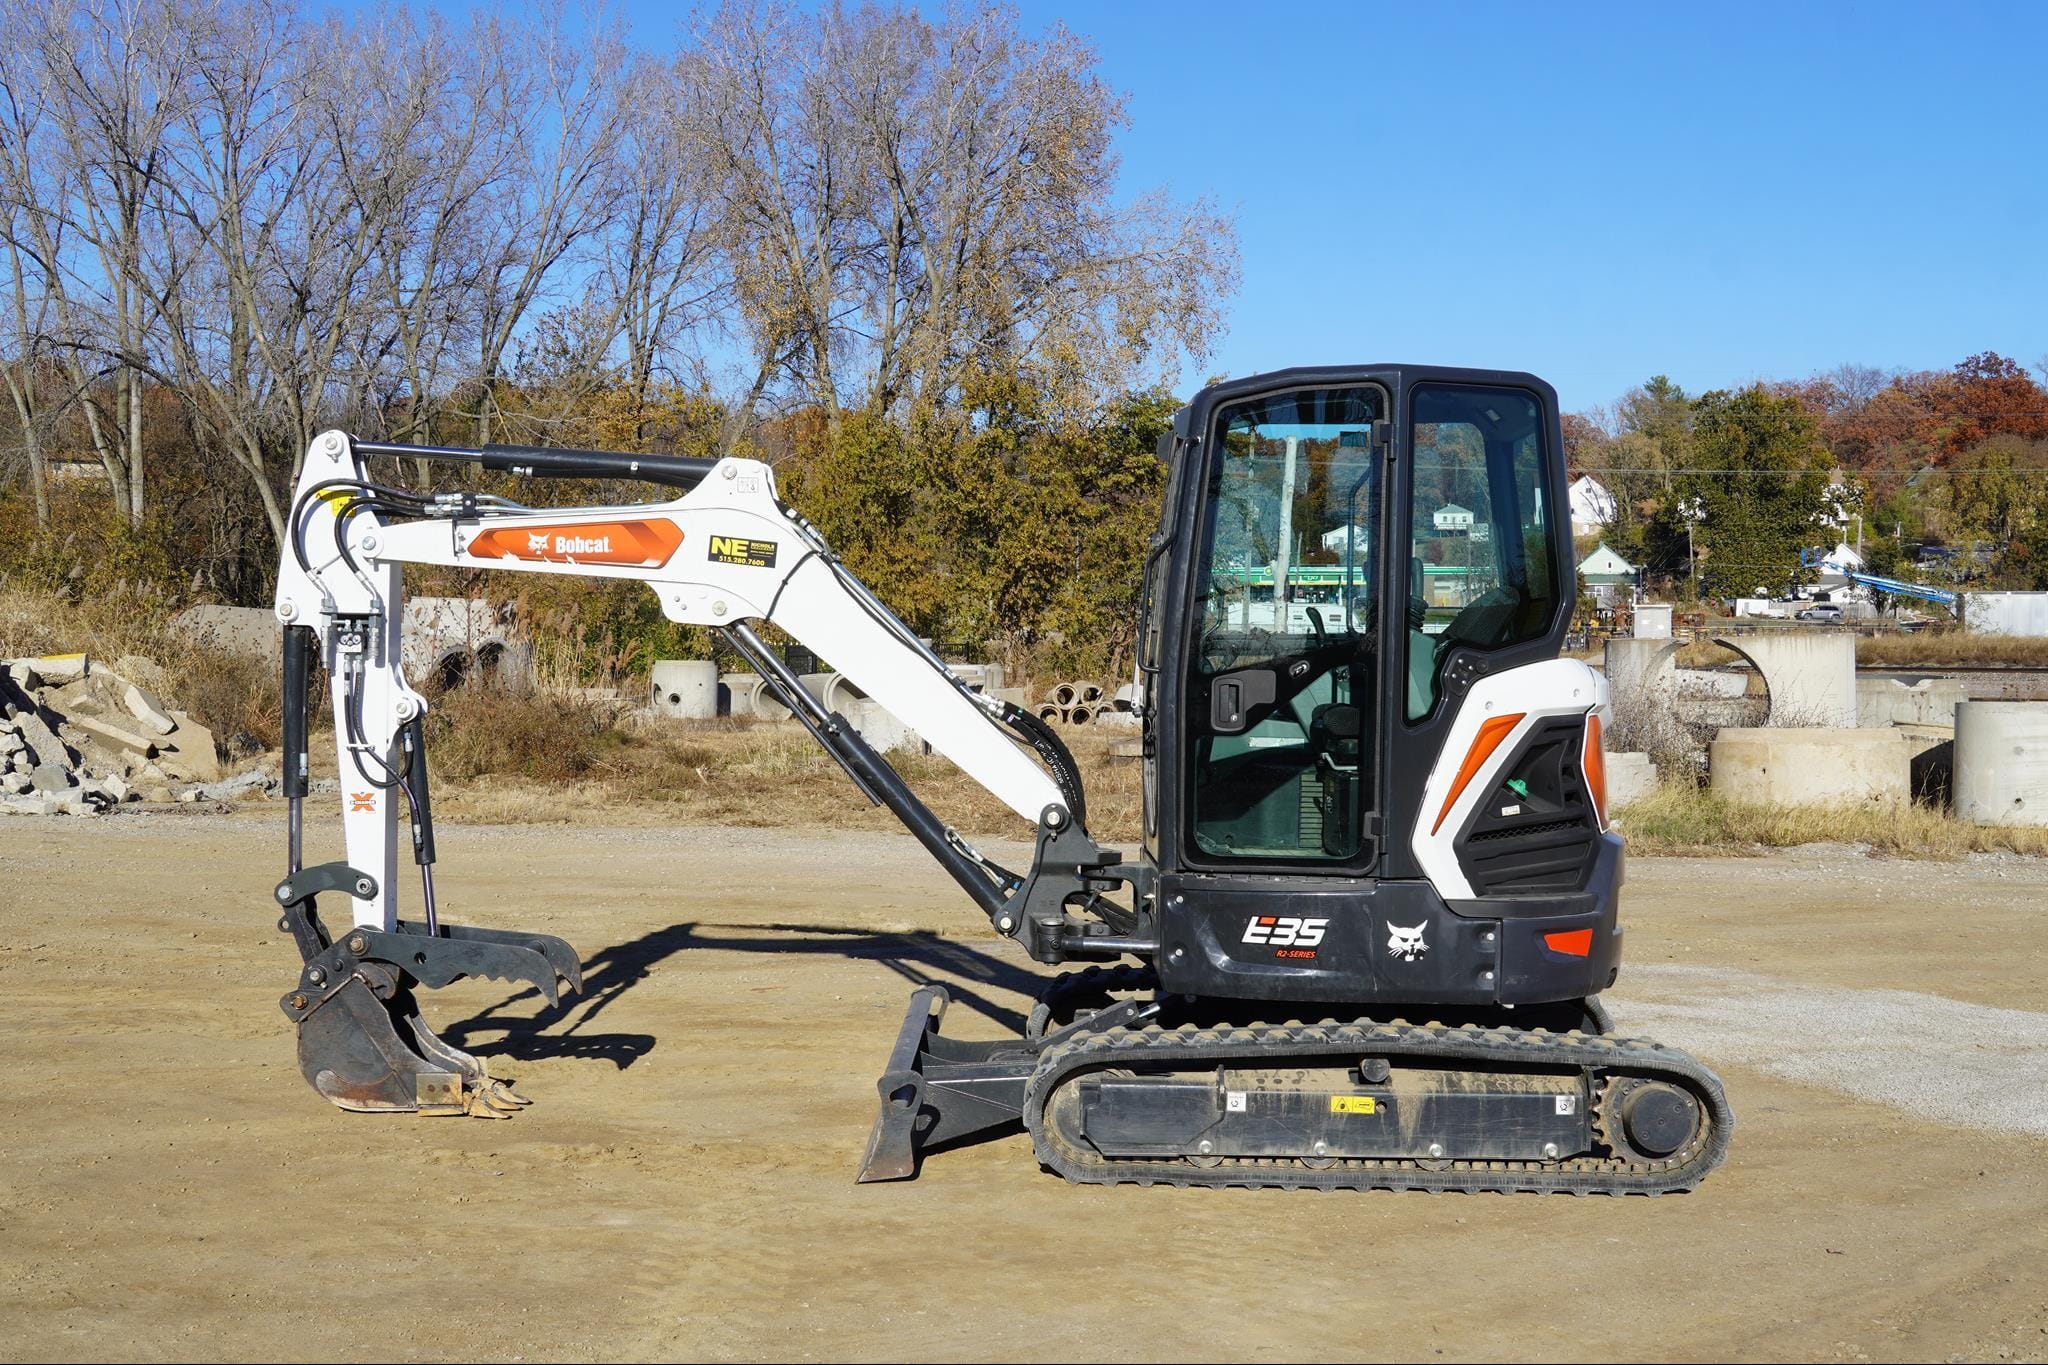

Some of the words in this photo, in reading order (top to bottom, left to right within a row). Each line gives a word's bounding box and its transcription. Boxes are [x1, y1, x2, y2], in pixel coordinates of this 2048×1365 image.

[555, 536, 609, 553] Bobcat
[711, 537, 749, 557] NE
[1241, 916, 1330, 946] E35
[1276, 950, 1316, 959] R2-SERIES
